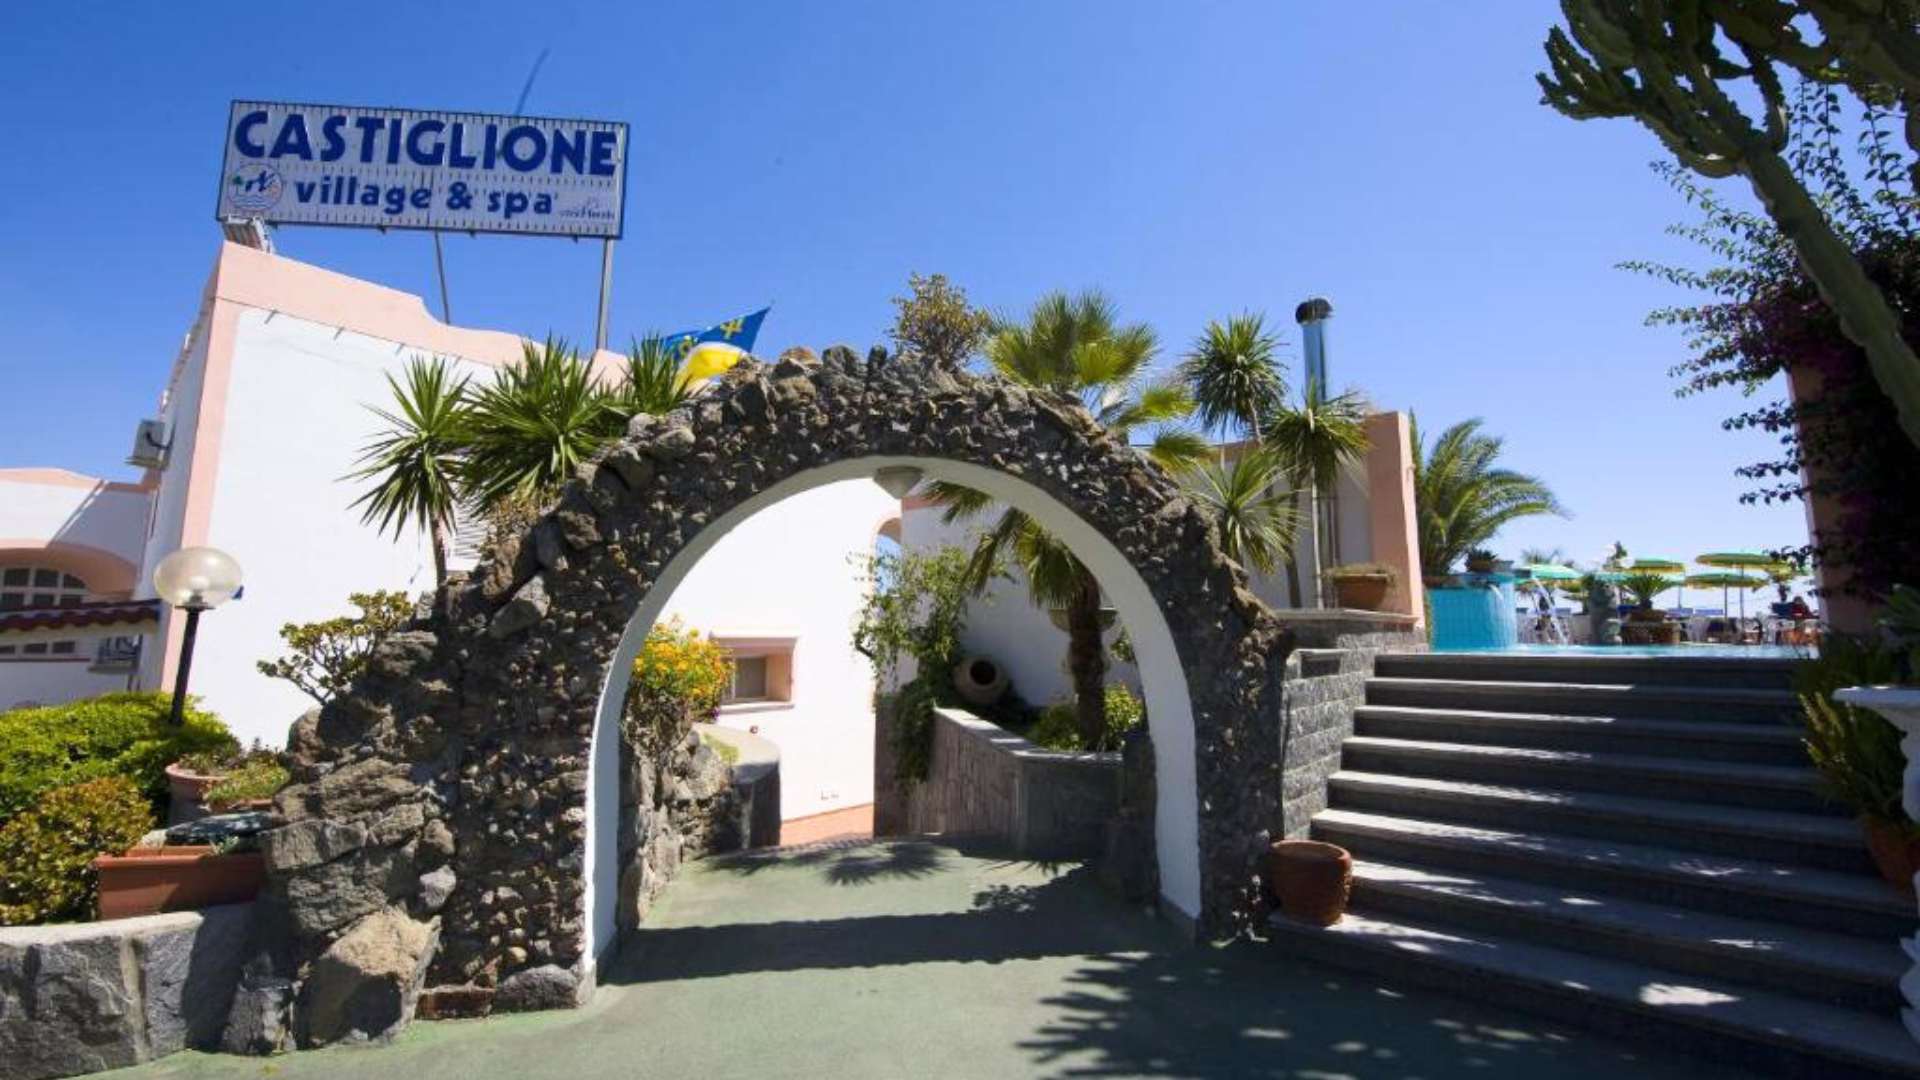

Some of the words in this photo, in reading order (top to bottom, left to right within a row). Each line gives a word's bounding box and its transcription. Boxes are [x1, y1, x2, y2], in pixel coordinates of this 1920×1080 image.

[234, 110, 618, 176] CASTIGLIONE
[295, 176, 432, 214] village
[446, 182, 473, 210] &
[487, 191, 552, 219] spa
